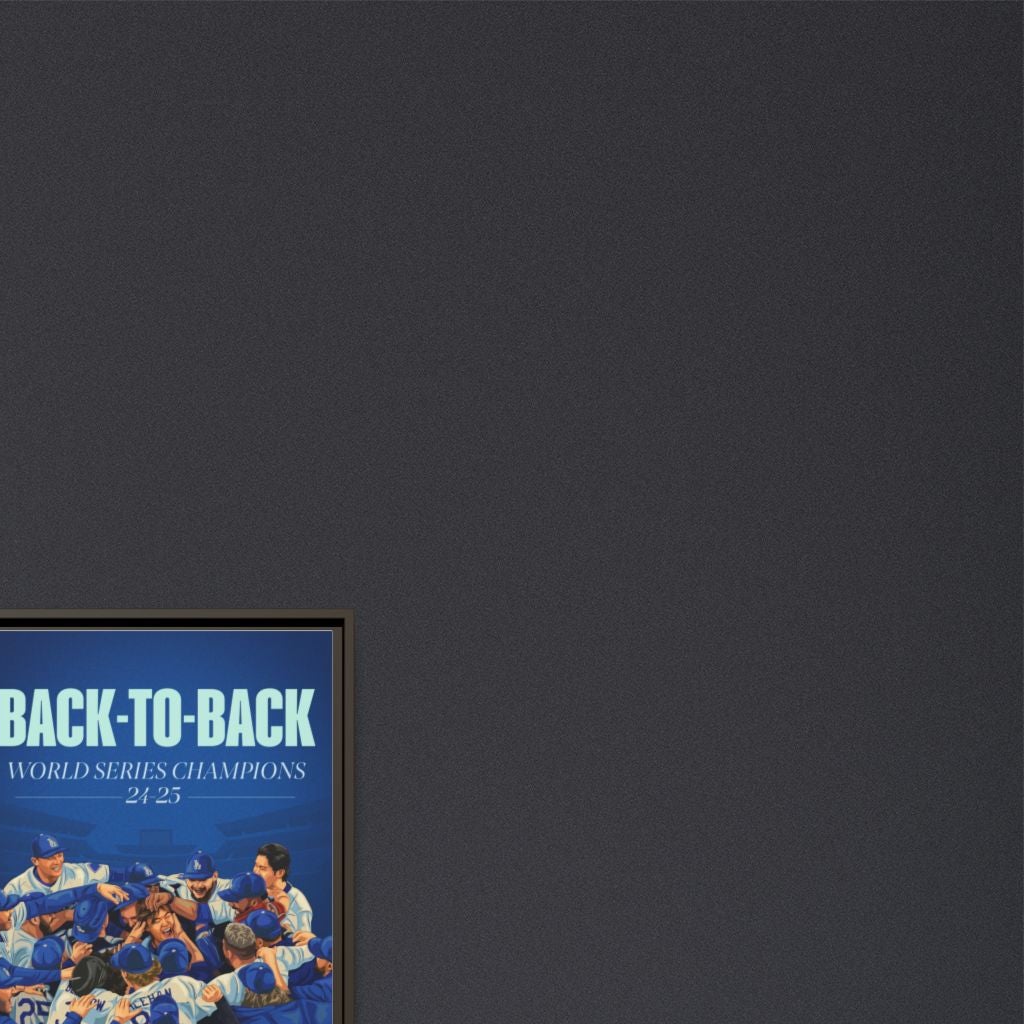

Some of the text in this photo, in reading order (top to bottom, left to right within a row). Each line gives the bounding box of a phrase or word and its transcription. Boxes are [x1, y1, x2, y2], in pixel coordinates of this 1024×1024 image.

[8, 761, 306, 780] WORLD SERIES CHAMPIONS
